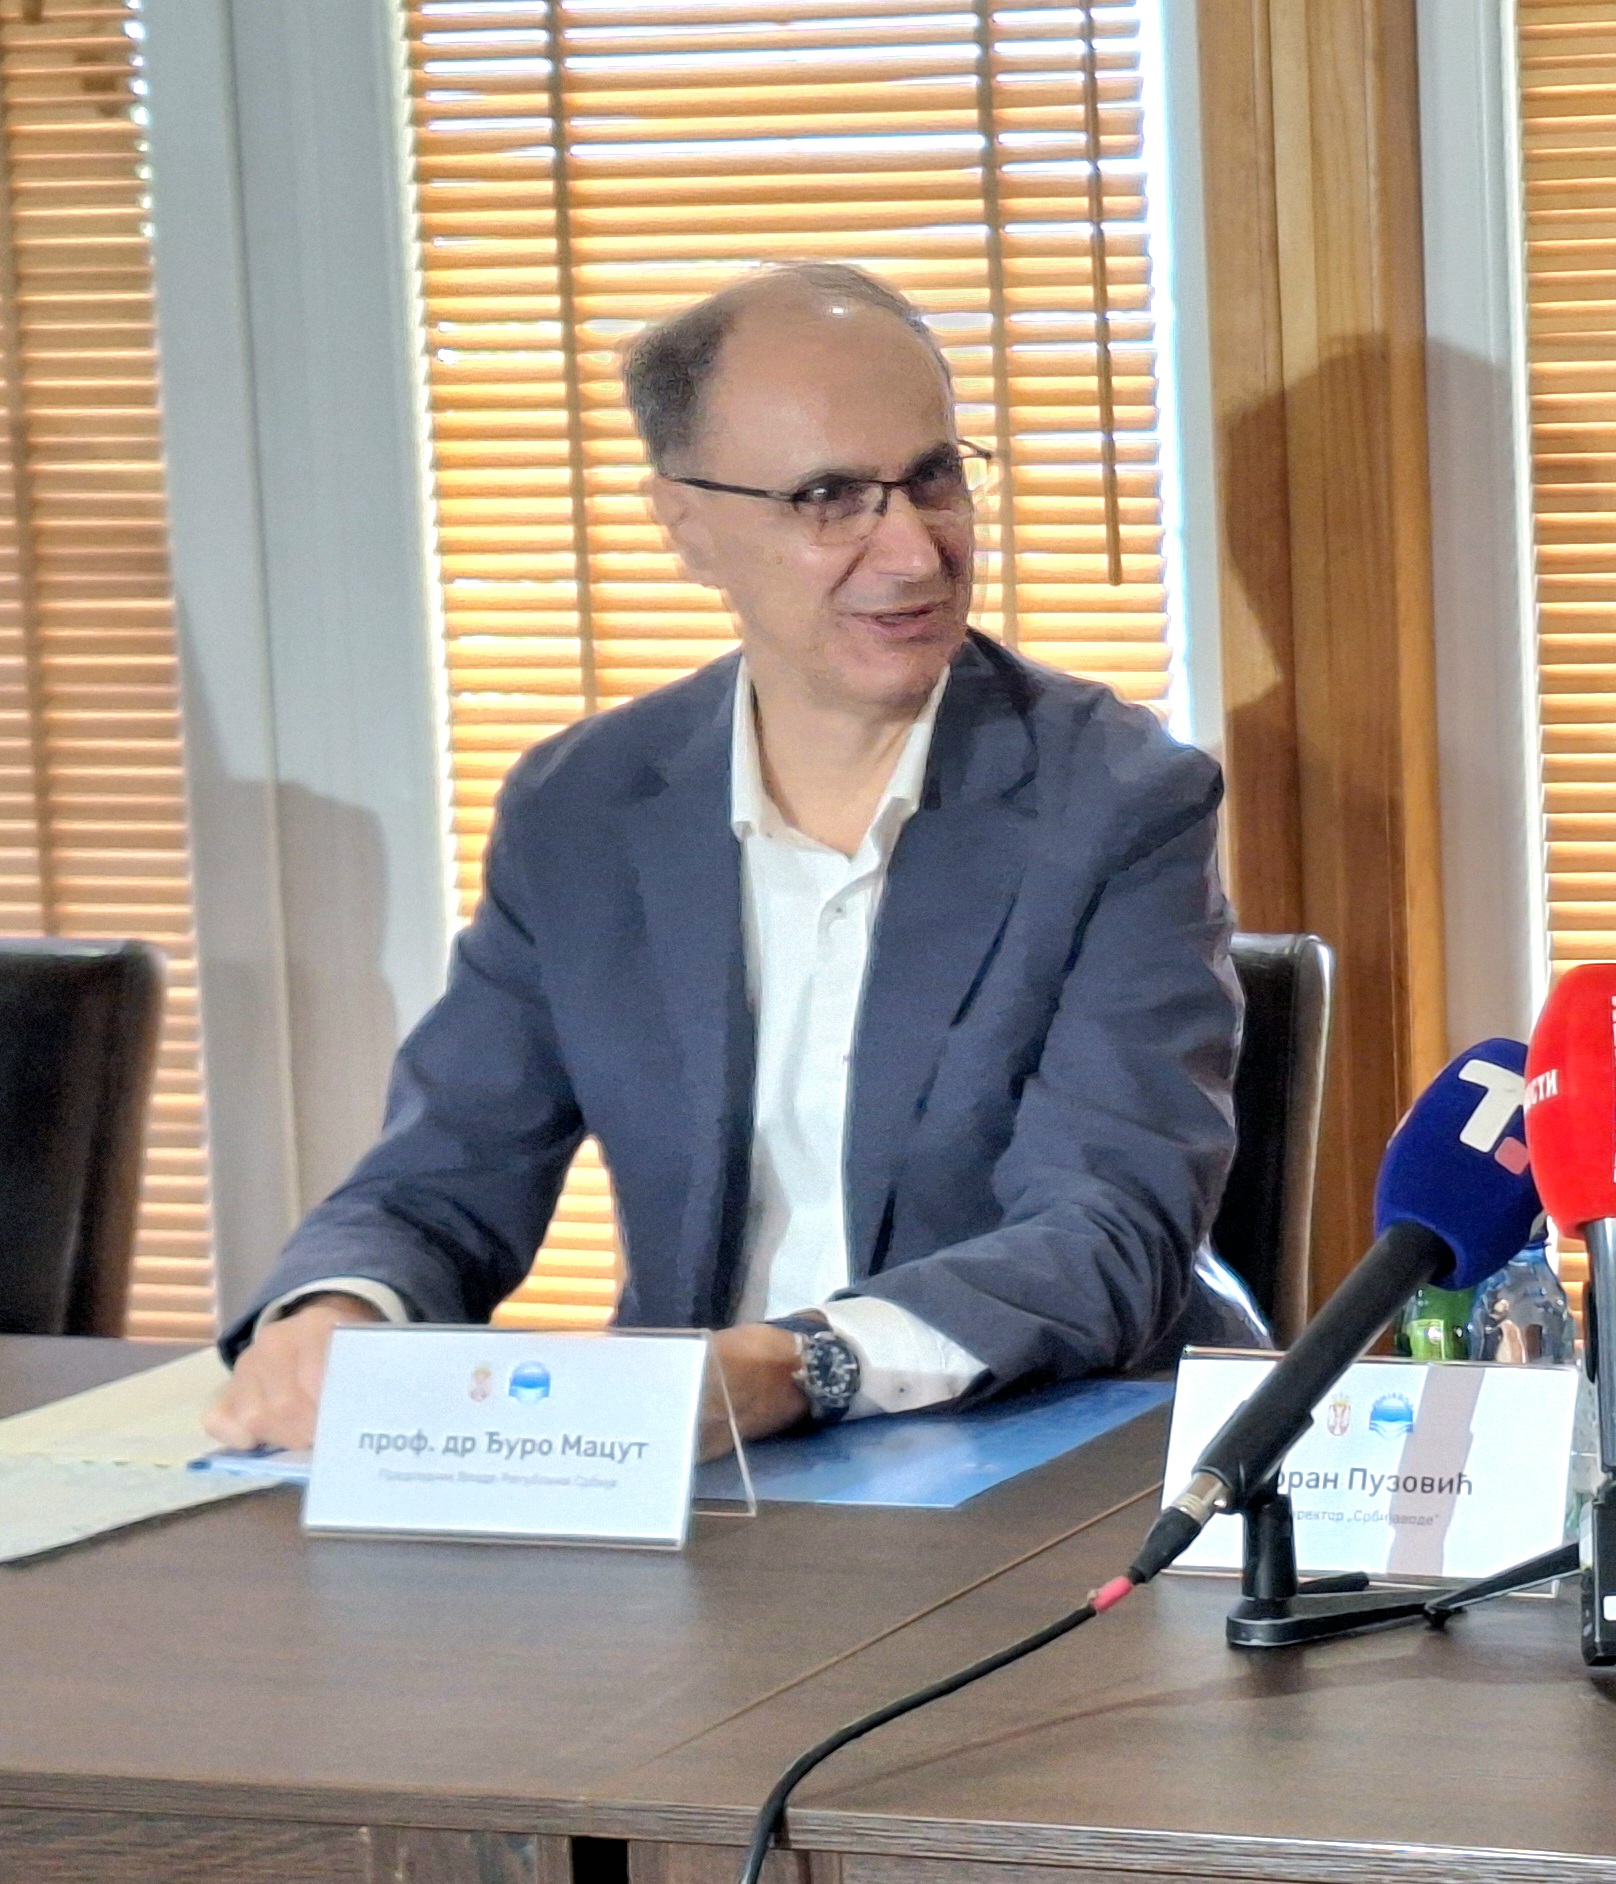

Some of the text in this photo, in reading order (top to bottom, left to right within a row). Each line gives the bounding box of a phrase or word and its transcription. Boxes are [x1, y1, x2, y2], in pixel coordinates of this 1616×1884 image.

[358, 1429, 434, 1456] проф.
[442, 1433, 477, 1457] др
[561, 1433, 649, 1464] Мацут
[1277, 1467, 1473, 1497] оран Пузовић
